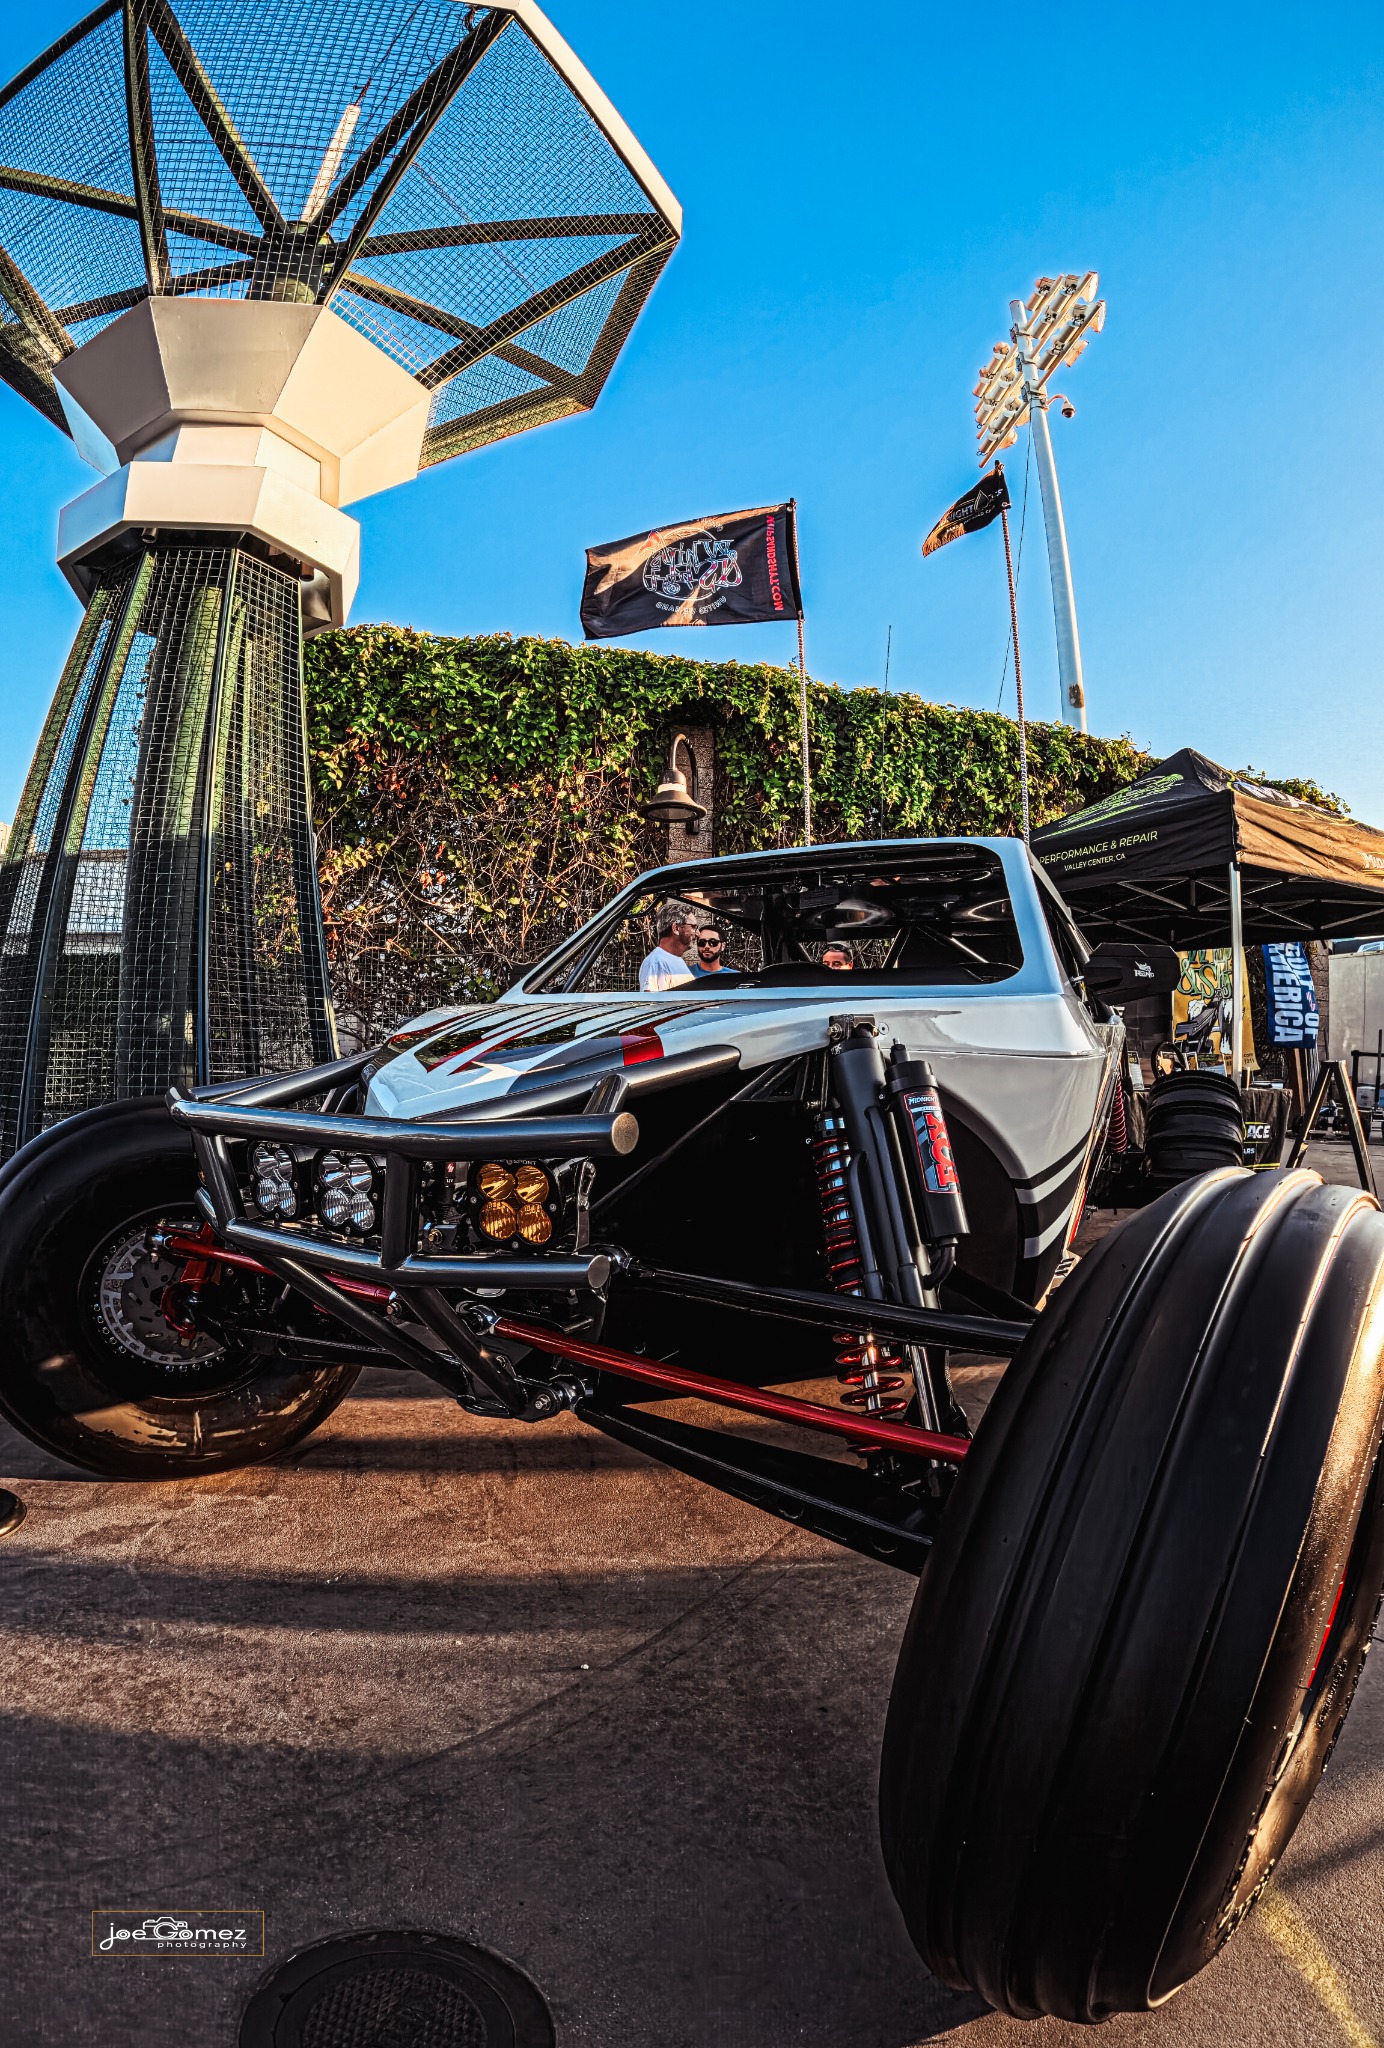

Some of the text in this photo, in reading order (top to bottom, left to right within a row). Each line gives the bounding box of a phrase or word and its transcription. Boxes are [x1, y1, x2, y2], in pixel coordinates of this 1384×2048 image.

[1039, 831, 1158, 865] PERFORMANCE & REPAIR
[1064, 861, 1087, 872] VALLEY
[1116, 853, 1126, 861] CA
[1285, 943, 1314, 991] GULF
[1304, 1012, 1319, 1040] OF
[925, 1113, 959, 1187] FOX
